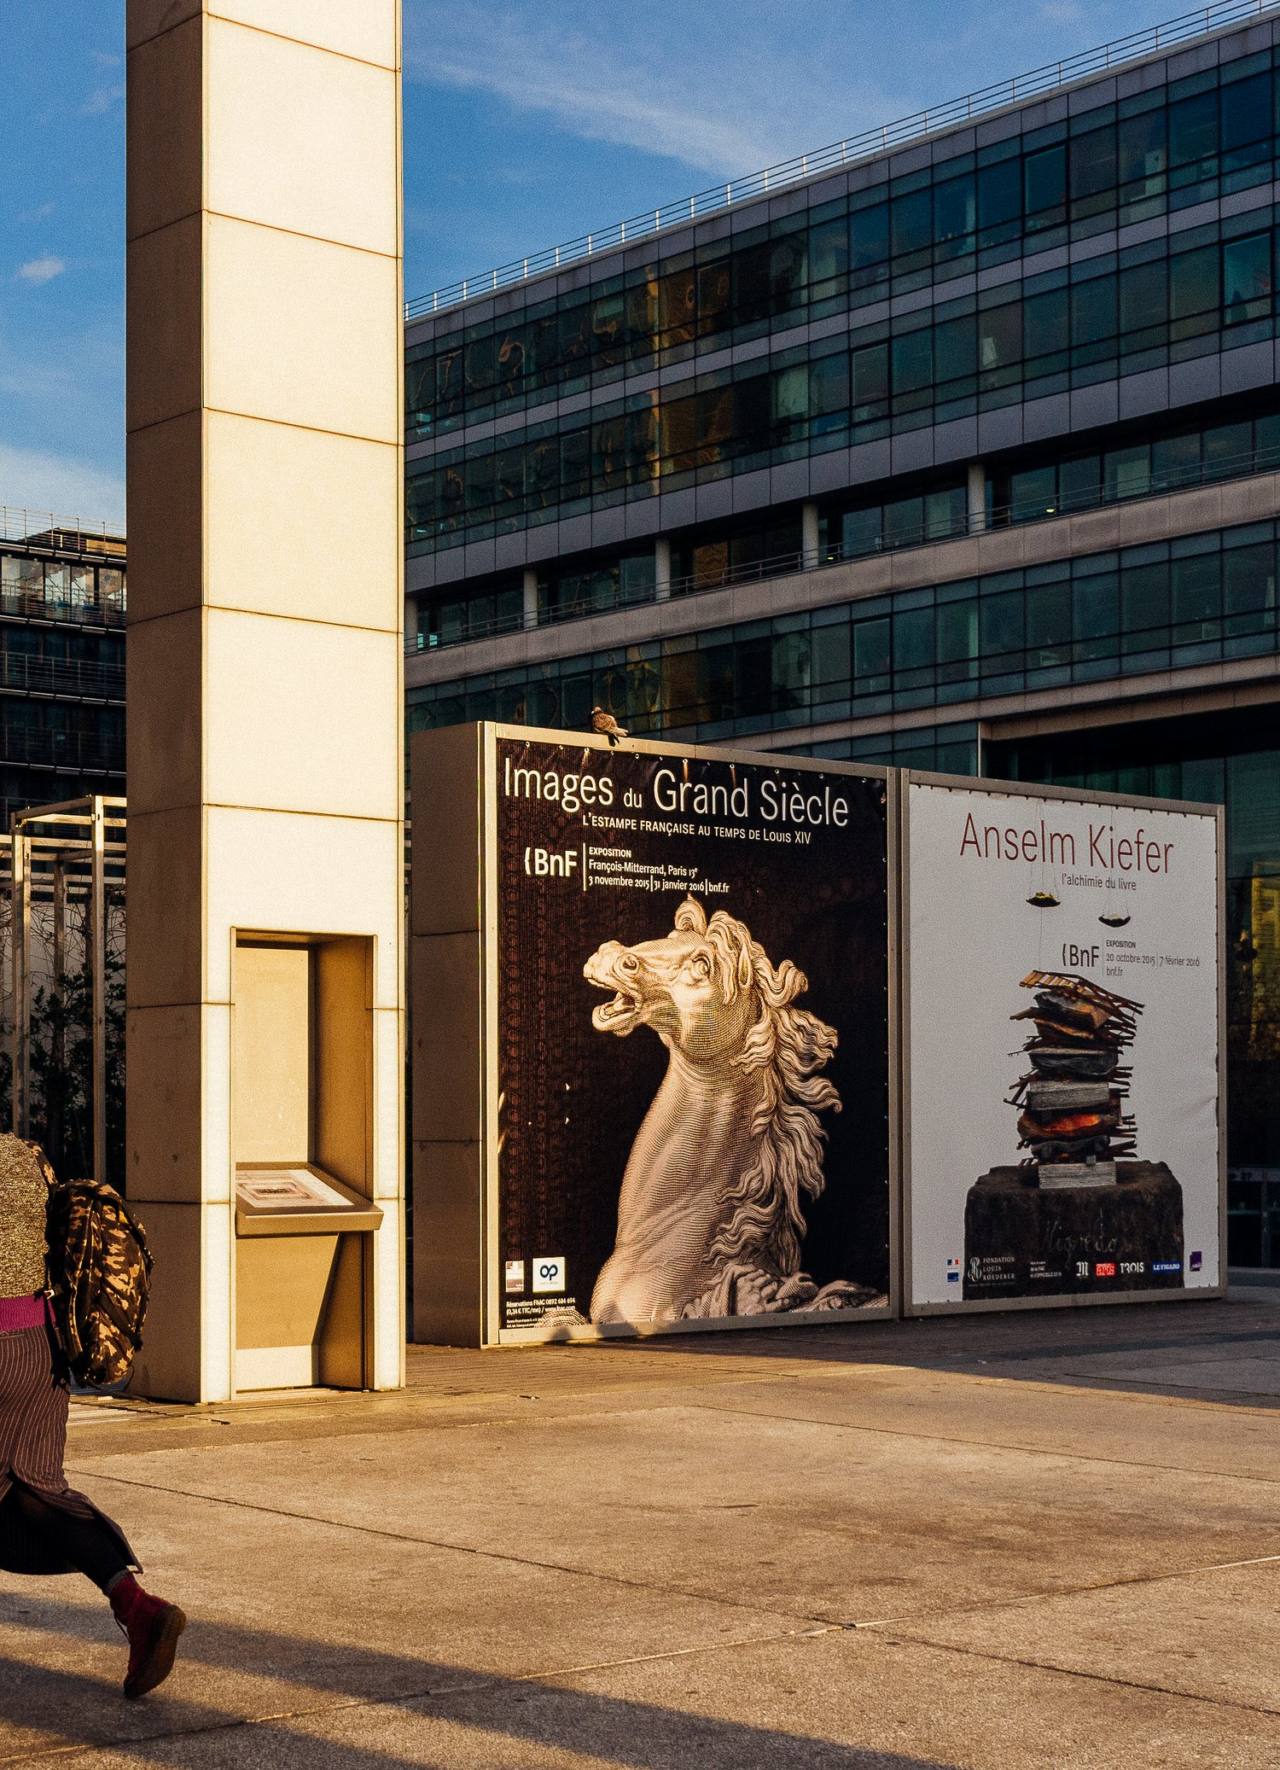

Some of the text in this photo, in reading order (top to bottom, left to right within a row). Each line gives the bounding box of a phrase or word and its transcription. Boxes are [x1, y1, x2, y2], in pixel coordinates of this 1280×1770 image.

[505, 757, 849, 827] Images du Grand Siècle
[582, 812, 637, 830] L'ESTAMPE
[640, 819, 695, 836] FRANÇAISE
[697, 825, 711, 836] AU
[713, 826, 746, 839] TEMPS
[748, 829, 761, 840] DE
[794, 831, 812, 845] XIV
[960, 812, 1174, 873] Anselm Kiefer
[589, 847, 632, 858] EXPOSITION
[668, 865, 687, 876] Paris
[588, 876, 593, 886] 3
[594, 876, 633, 887] novembre
[634, 879, 649, 889] 2015
[661, 879, 687, 891] janvier
[689, 882, 704, 891] 2016
[708, 882, 730, 893] bnf.fr
[1061, 873, 1137, 891] l'alchimie du livre
[1106, 940, 1136, 949] EXPOSITION
[1115, 953, 1141, 963] octobre
